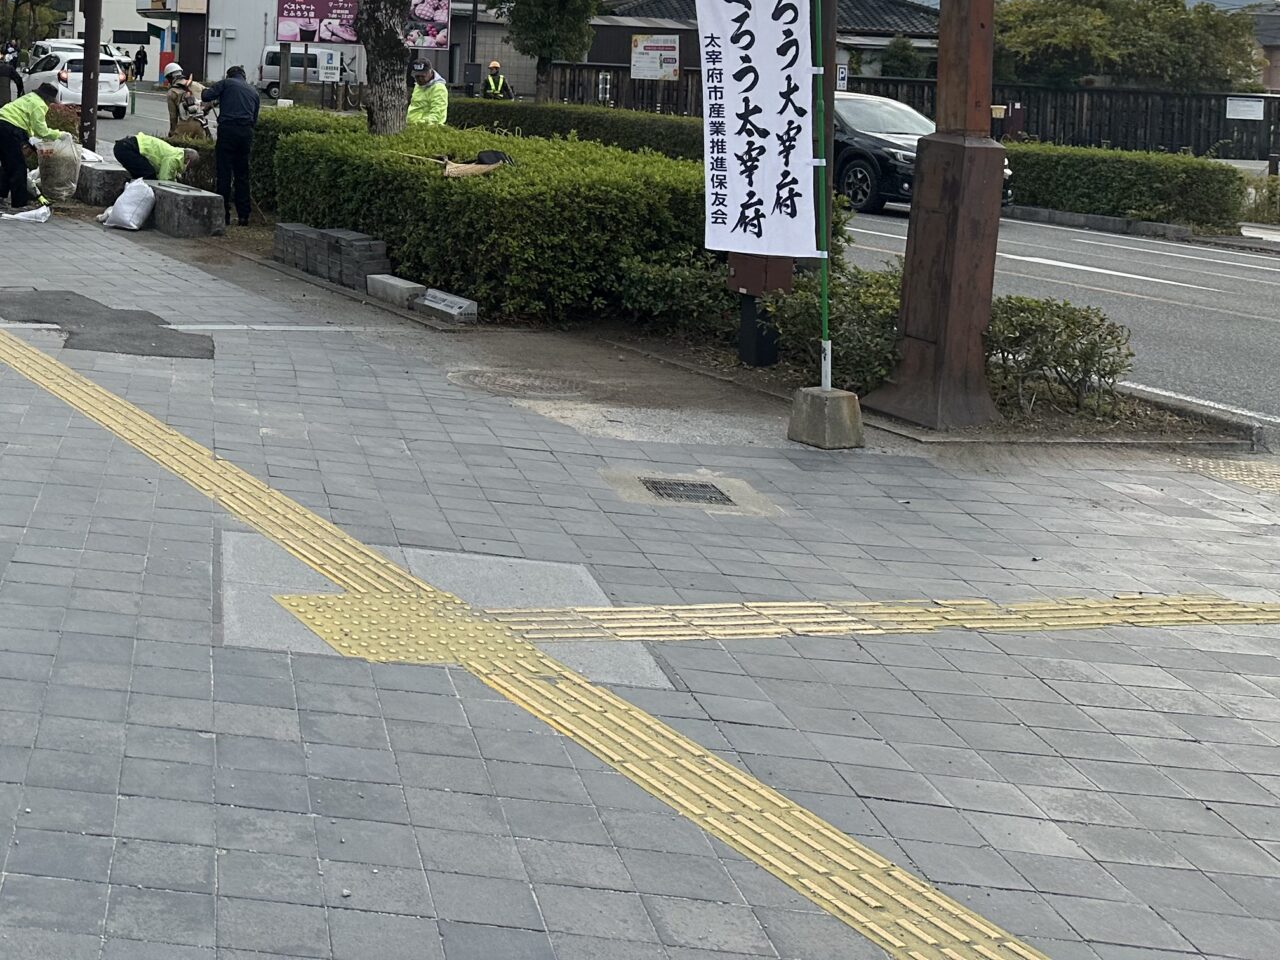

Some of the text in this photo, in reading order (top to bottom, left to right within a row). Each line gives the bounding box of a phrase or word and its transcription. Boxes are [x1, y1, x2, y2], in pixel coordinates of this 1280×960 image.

[283, 2, 316, 11] ベストマート
[703, 33, 728, 226] 太宰府市産業推進保友会
